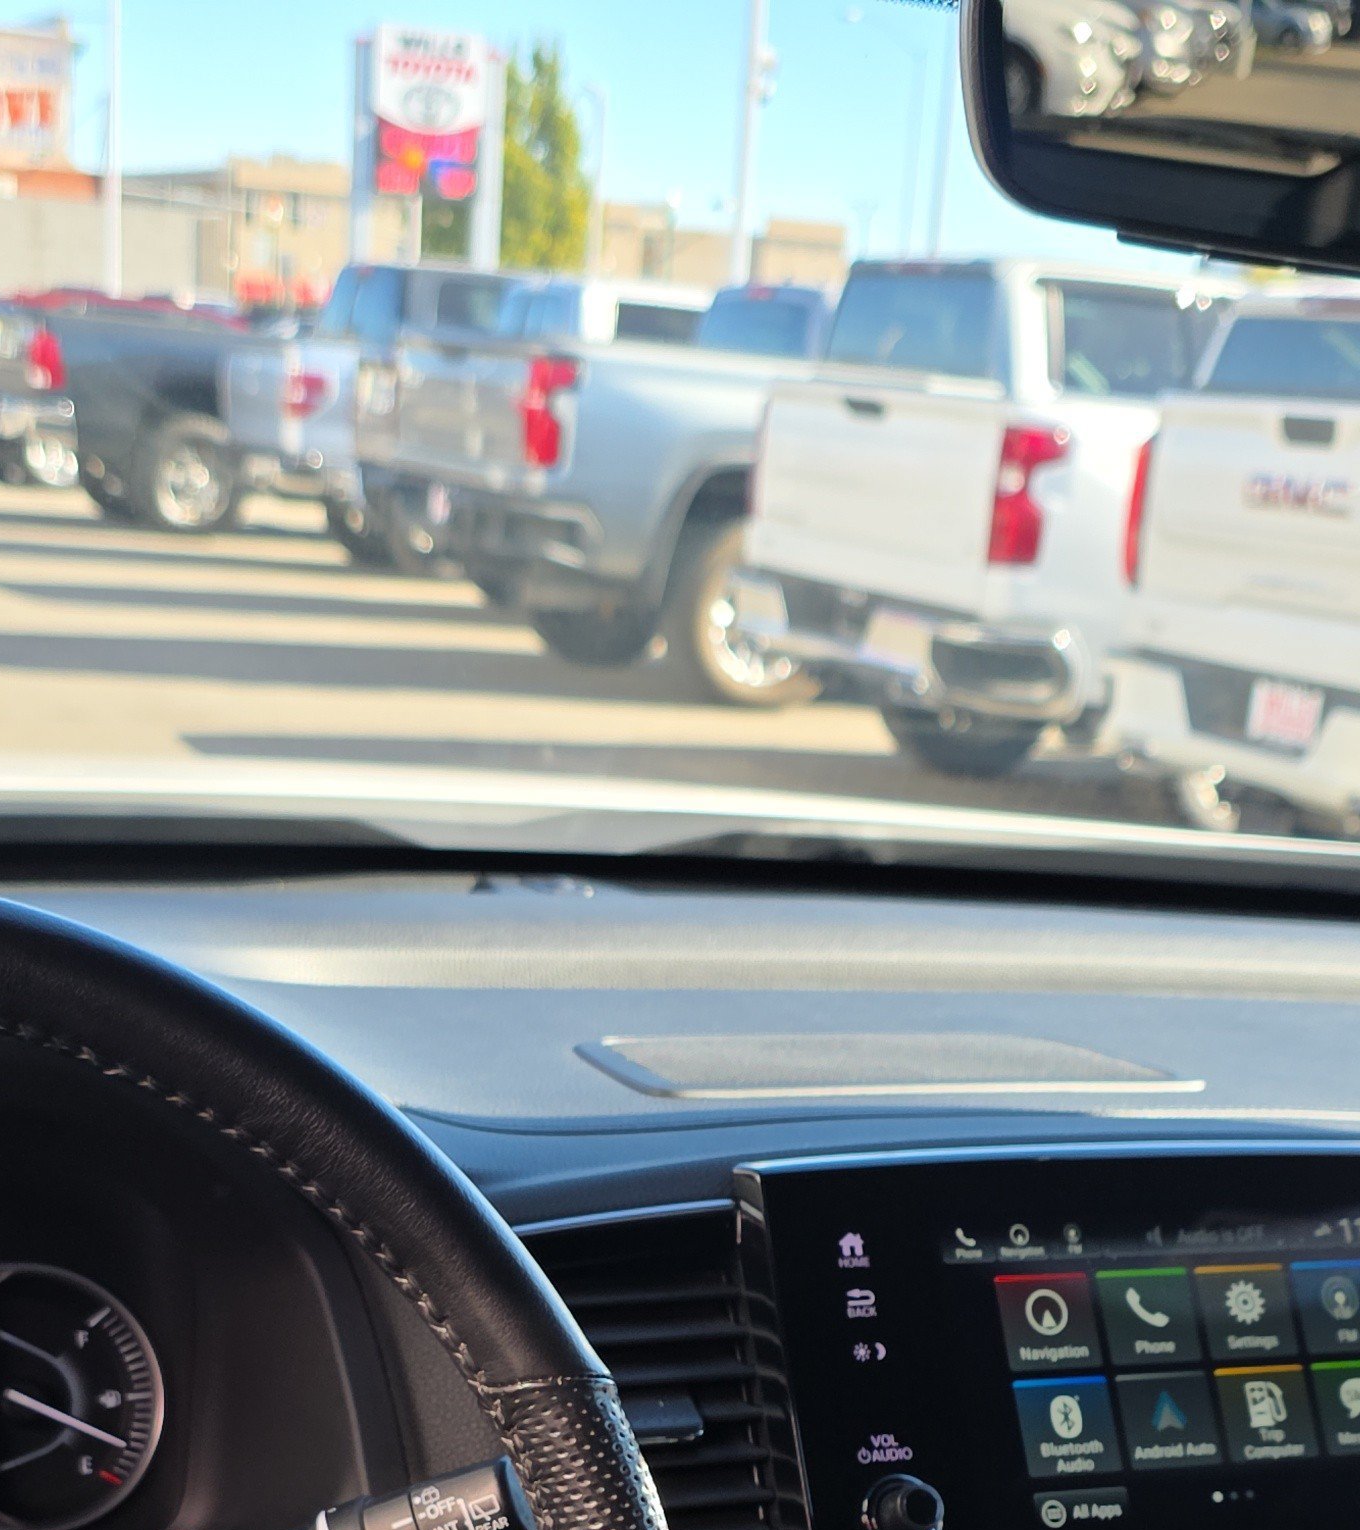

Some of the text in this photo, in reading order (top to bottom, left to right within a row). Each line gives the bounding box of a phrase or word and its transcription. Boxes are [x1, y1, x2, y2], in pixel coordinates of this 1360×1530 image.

[838, 1256, 870, 1268] HOME
[847, 1306, 878, 1318] BACK
[74, 1329, 89, 1349] F
[1227, 1334, 1280, 1350] Settings
[1337, 1327, 1360, 1343] FM
[1019, 1345, 1090, 1363] Navigation
[1135, 1339, 1177, 1355] Phone
[870, 1433, 899, 1448] VOL
[1040, 1438, 1105, 1458] Bluetooth
[872, 1446, 913, 1462] AUDIO
[1134, 1441, 1218, 1460] Android Auto
[1244, 1442, 1305, 1460] Computer
[78, 1455, 94, 1475] E
[1056, 1457, 1095, 1474] Audio
[426, 1496, 455, 1519] OFF
[1073, 1502, 1123, 1520] All Apps
